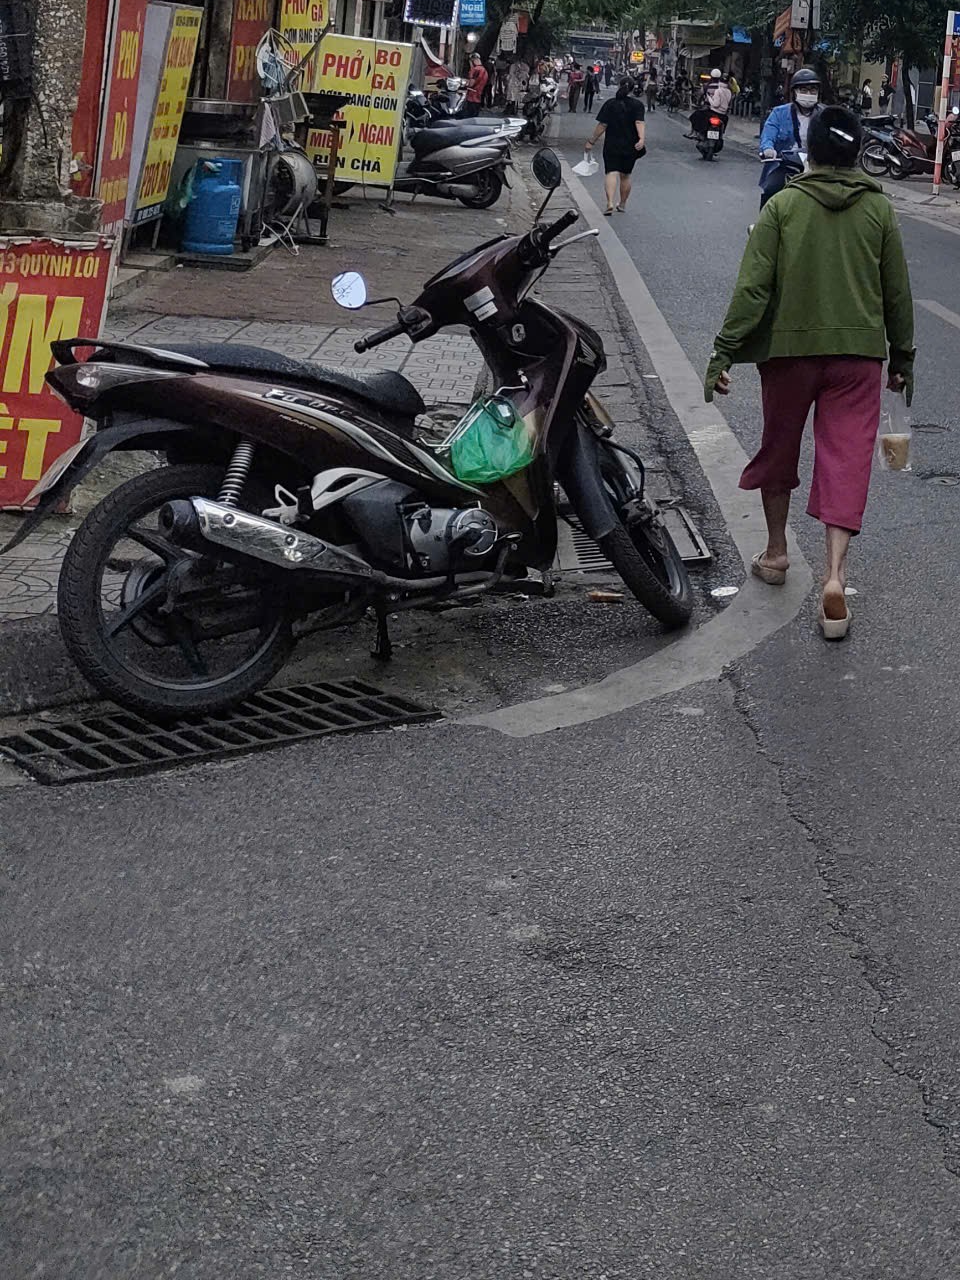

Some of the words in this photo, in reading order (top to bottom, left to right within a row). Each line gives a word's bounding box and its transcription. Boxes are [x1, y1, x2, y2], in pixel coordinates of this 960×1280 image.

[321, 49, 365, 80] PHỞ
[375, 47, 402, 67] BÒ
[371, 73, 396, 91] GÀ
[358, 122, 395, 147] NGAN
[351, 156, 381, 174] CHẢ
[20, 252, 73, 279] QUỲNH
[74, 251, 101, 279] LÔI
